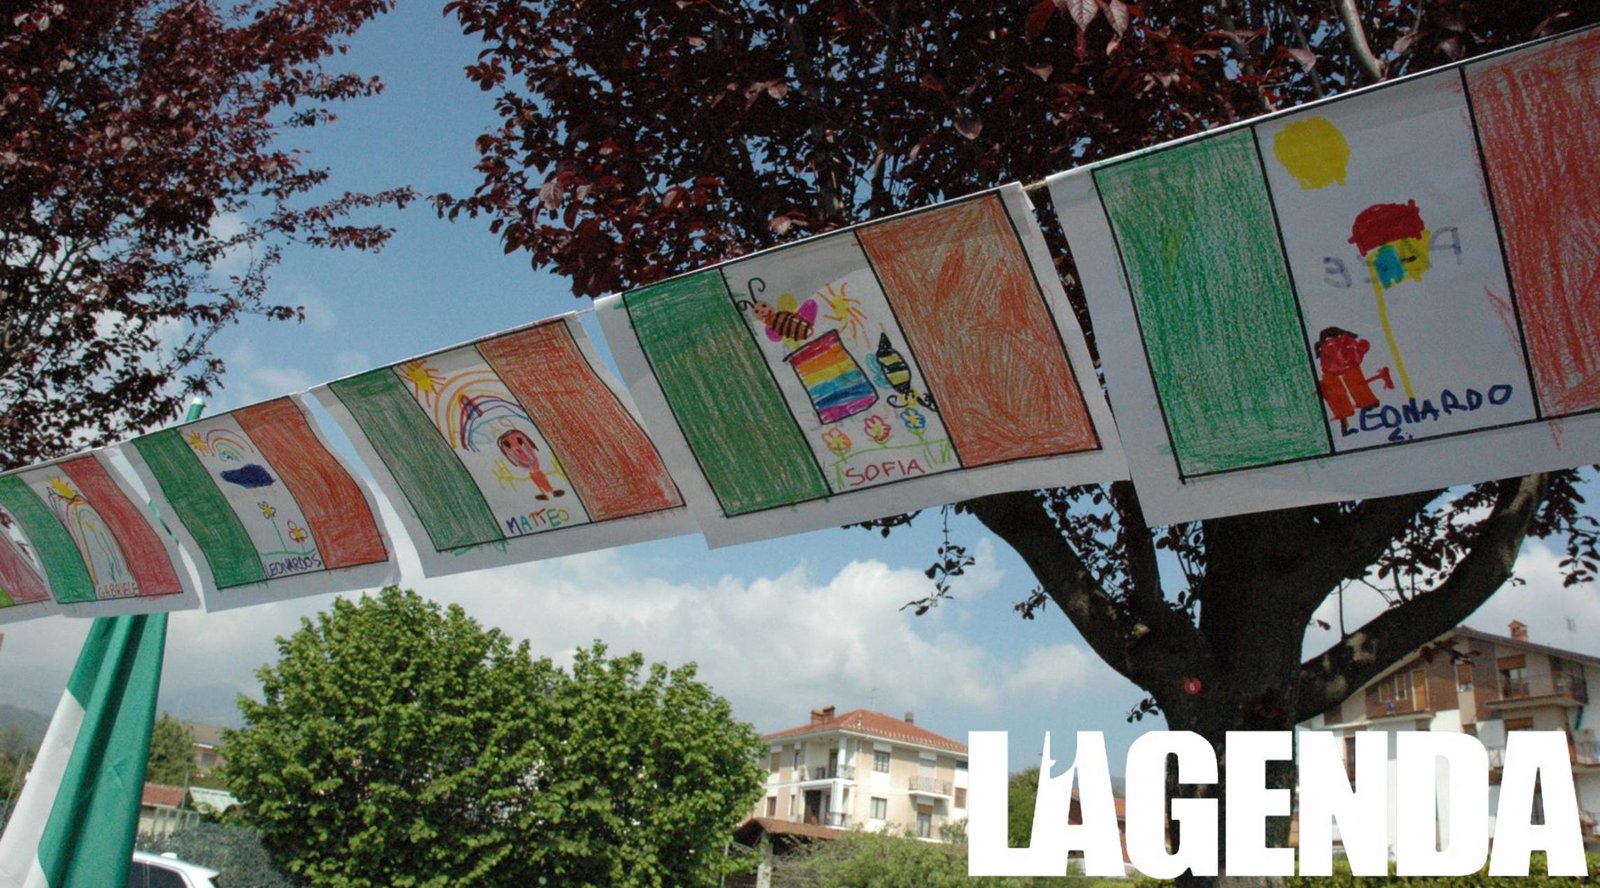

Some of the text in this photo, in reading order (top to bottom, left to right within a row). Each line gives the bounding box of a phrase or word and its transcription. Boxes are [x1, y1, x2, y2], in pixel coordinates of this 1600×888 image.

[1340, 383, 1513, 438] LEONARDO
[844, 458, 926, 487] SOFIA
[505, 507, 570, 535] MATTEO
